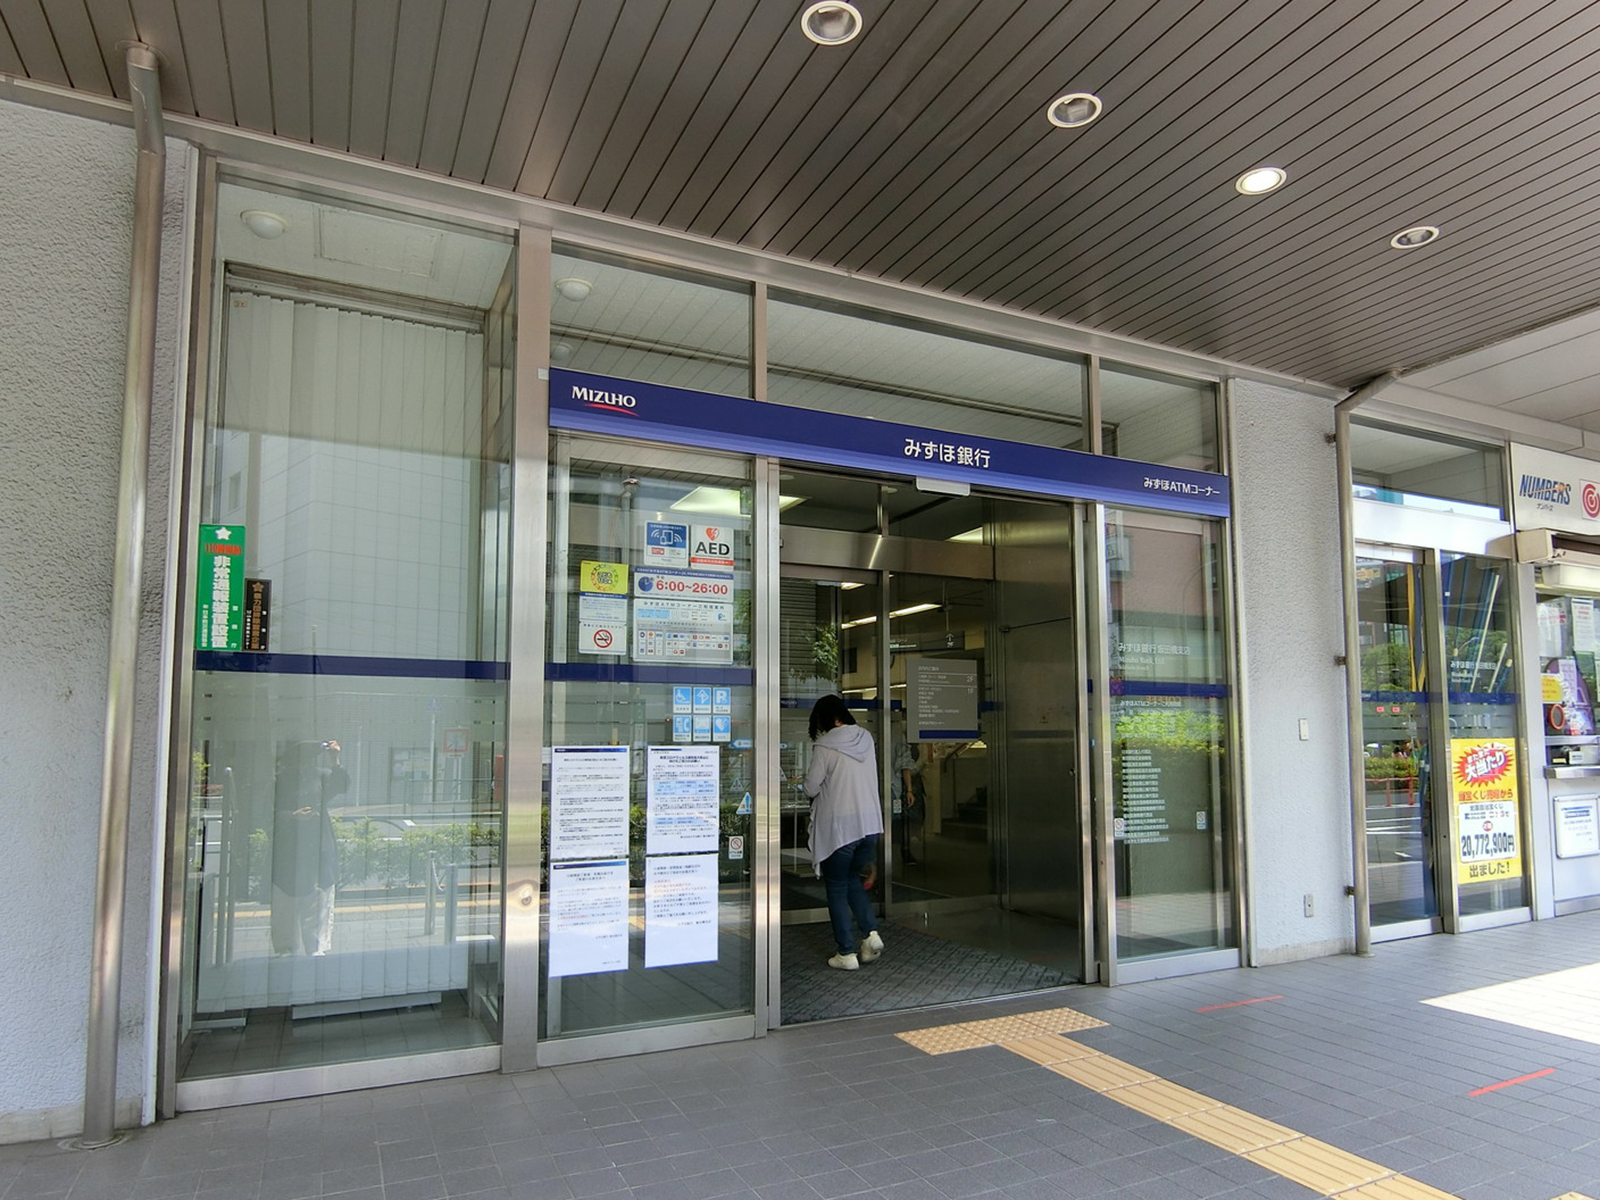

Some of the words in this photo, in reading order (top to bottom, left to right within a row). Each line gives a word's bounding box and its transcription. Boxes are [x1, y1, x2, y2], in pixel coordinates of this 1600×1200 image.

[571, 385, 637, 408] MIZUHO
[903, 438, 991, 469] みずほ銀行
[1143, 477, 1221, 496] みずほATMコーナー
[1519, 474, 1572, 506] NUMBERS
[695, 541, 730, 556] AED
[1118, 643, 1156, 653] みずほ銀行
[1465, 750, 1505, 782] 大当たり
[1461, 832, 1515, 859] 20,772,900円
[1469, 862, 1510, 878] 出ました!
